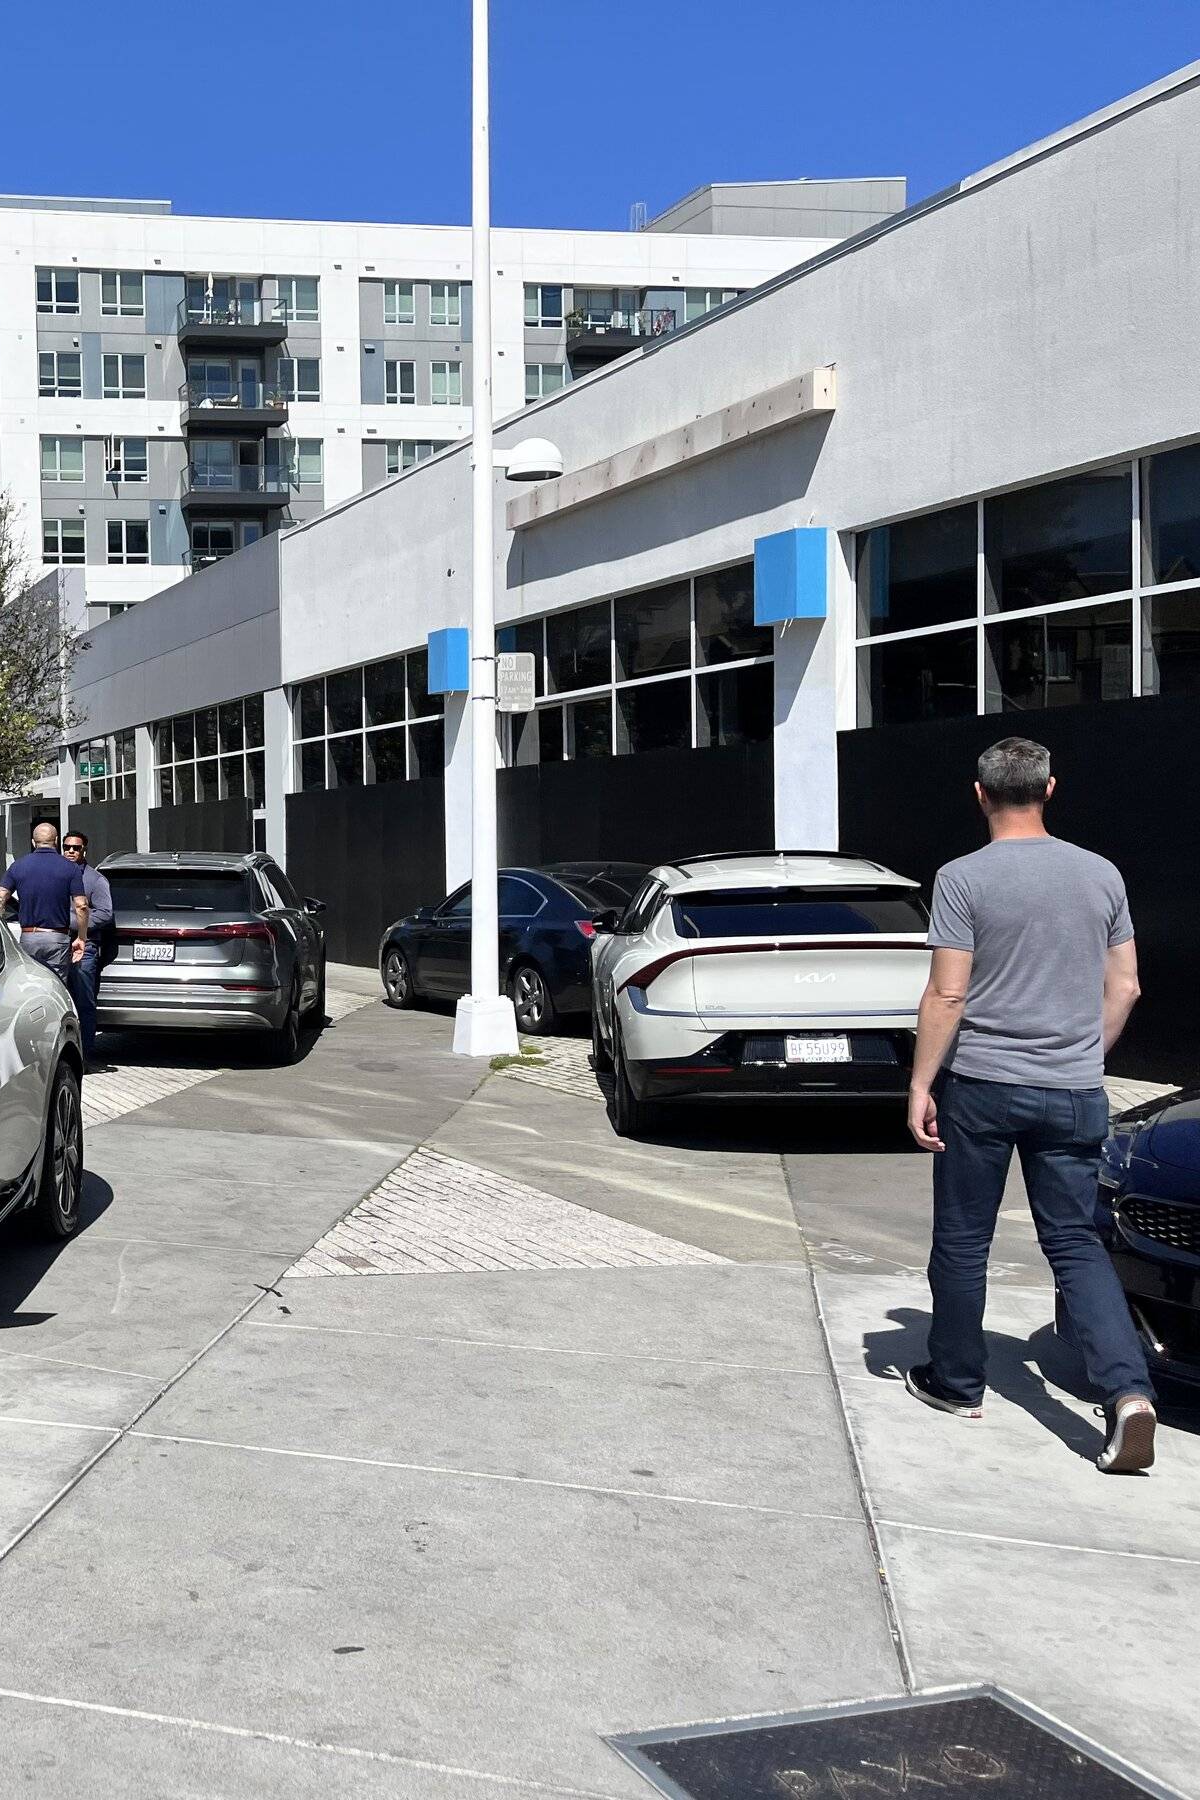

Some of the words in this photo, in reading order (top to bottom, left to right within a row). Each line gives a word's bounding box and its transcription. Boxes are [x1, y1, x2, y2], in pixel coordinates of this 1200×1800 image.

[501, 656, 514, 669] NO
[500, 671, 532, 682] PARKING
[135, 947, 173, 959] 8PRJ392
[793, 971, 837, 984] KIA
